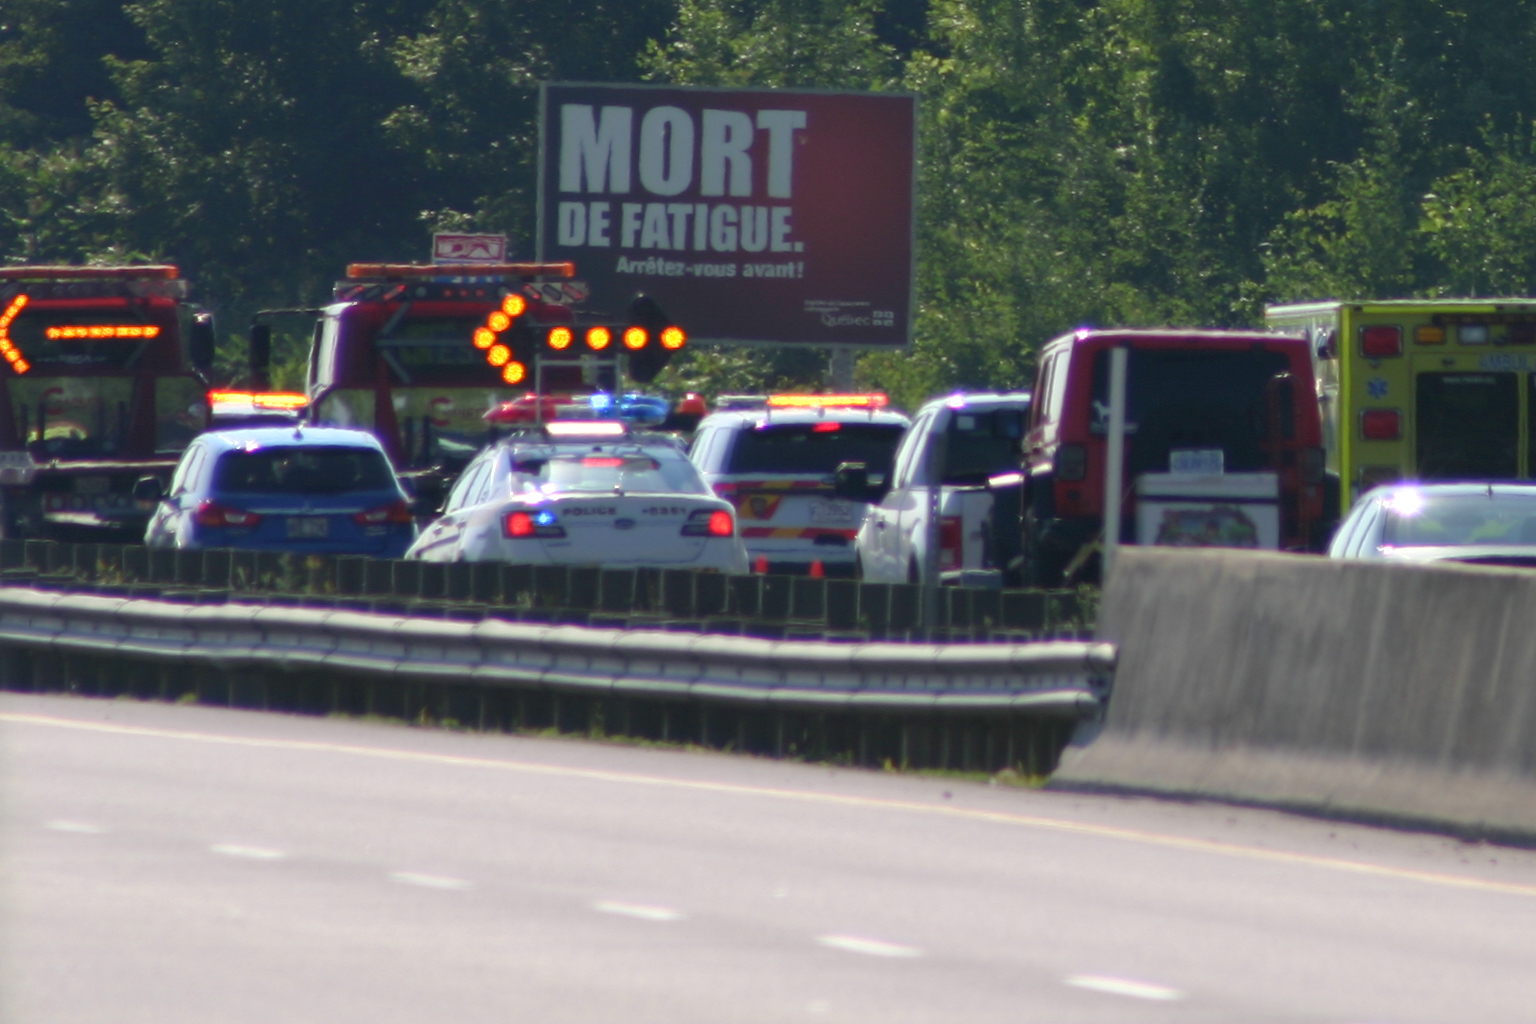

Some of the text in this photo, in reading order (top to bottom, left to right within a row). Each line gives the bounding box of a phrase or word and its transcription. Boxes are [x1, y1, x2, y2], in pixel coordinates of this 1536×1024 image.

[559, 103, 807, 198] MORT
[558, 201, 805, 252] DE FATIGUE.
[616, 256, 805, 279] Arrêtez-vous avant!
[562, 507, 617, 517] POLICE
